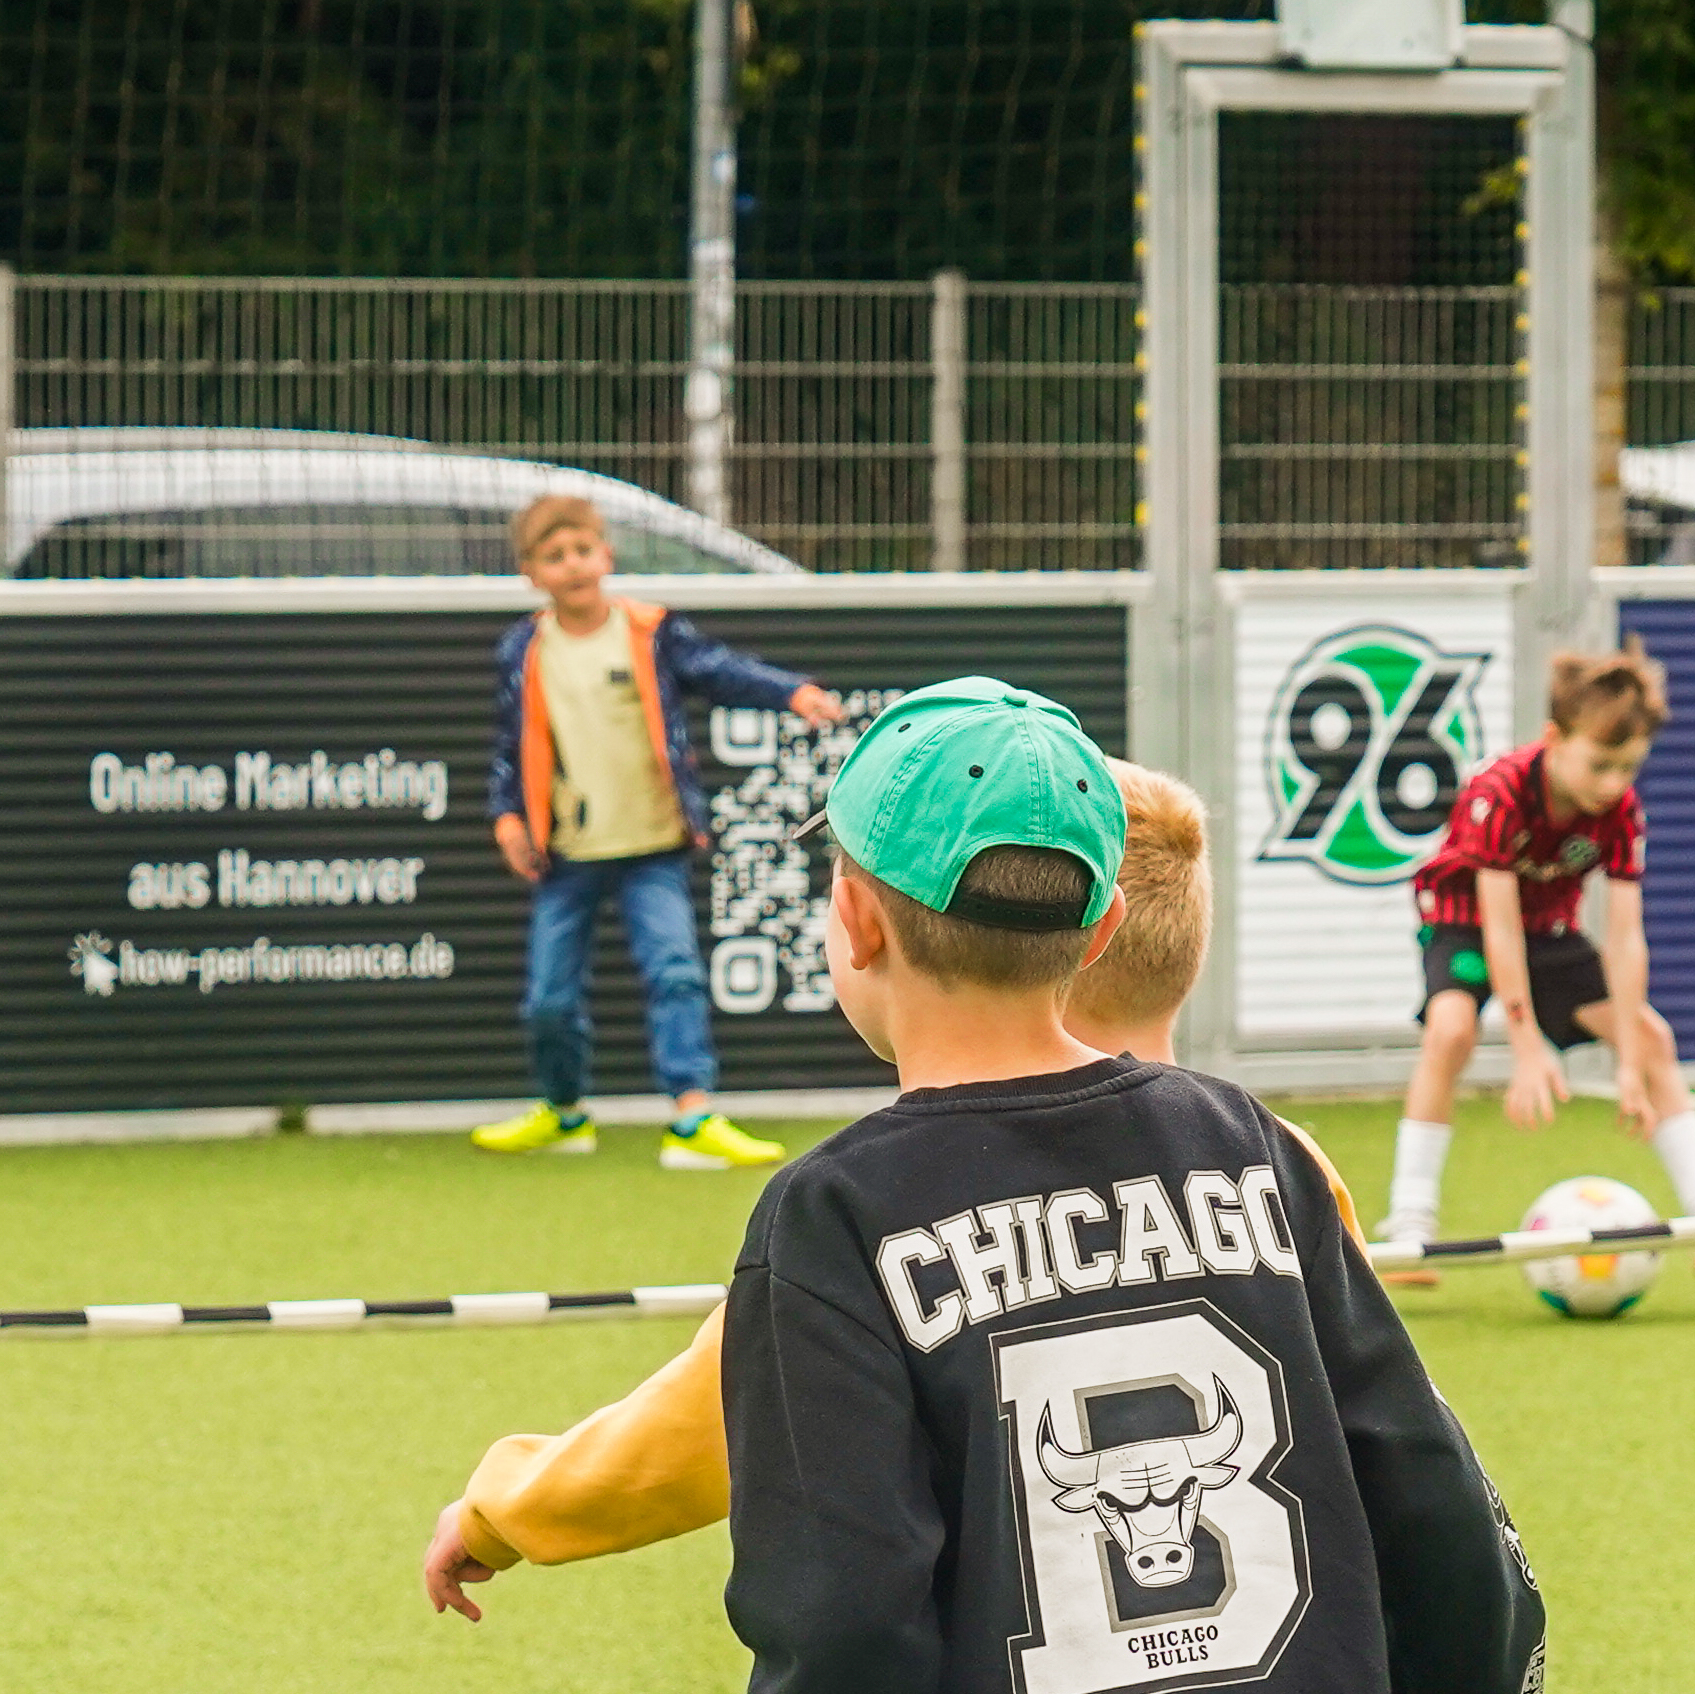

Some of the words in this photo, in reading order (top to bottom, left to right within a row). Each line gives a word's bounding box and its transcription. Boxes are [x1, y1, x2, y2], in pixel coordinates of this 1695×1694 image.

[90, 752, 228, 814] Online
[235, 748, 448, 821] Marketing
[1283, 669, 1464, 841] 96
[127, 862, 211, 911] aus
[217, 848, 425, 908] Hannover
[119, 932, 455, 995] how-performance.de
[876, 1164, 1304, 1353] CHICAGO
[1128, 1625, 1218, 1653] CHICAGO
[1146, 1645, 1208, 1669] BULLS
